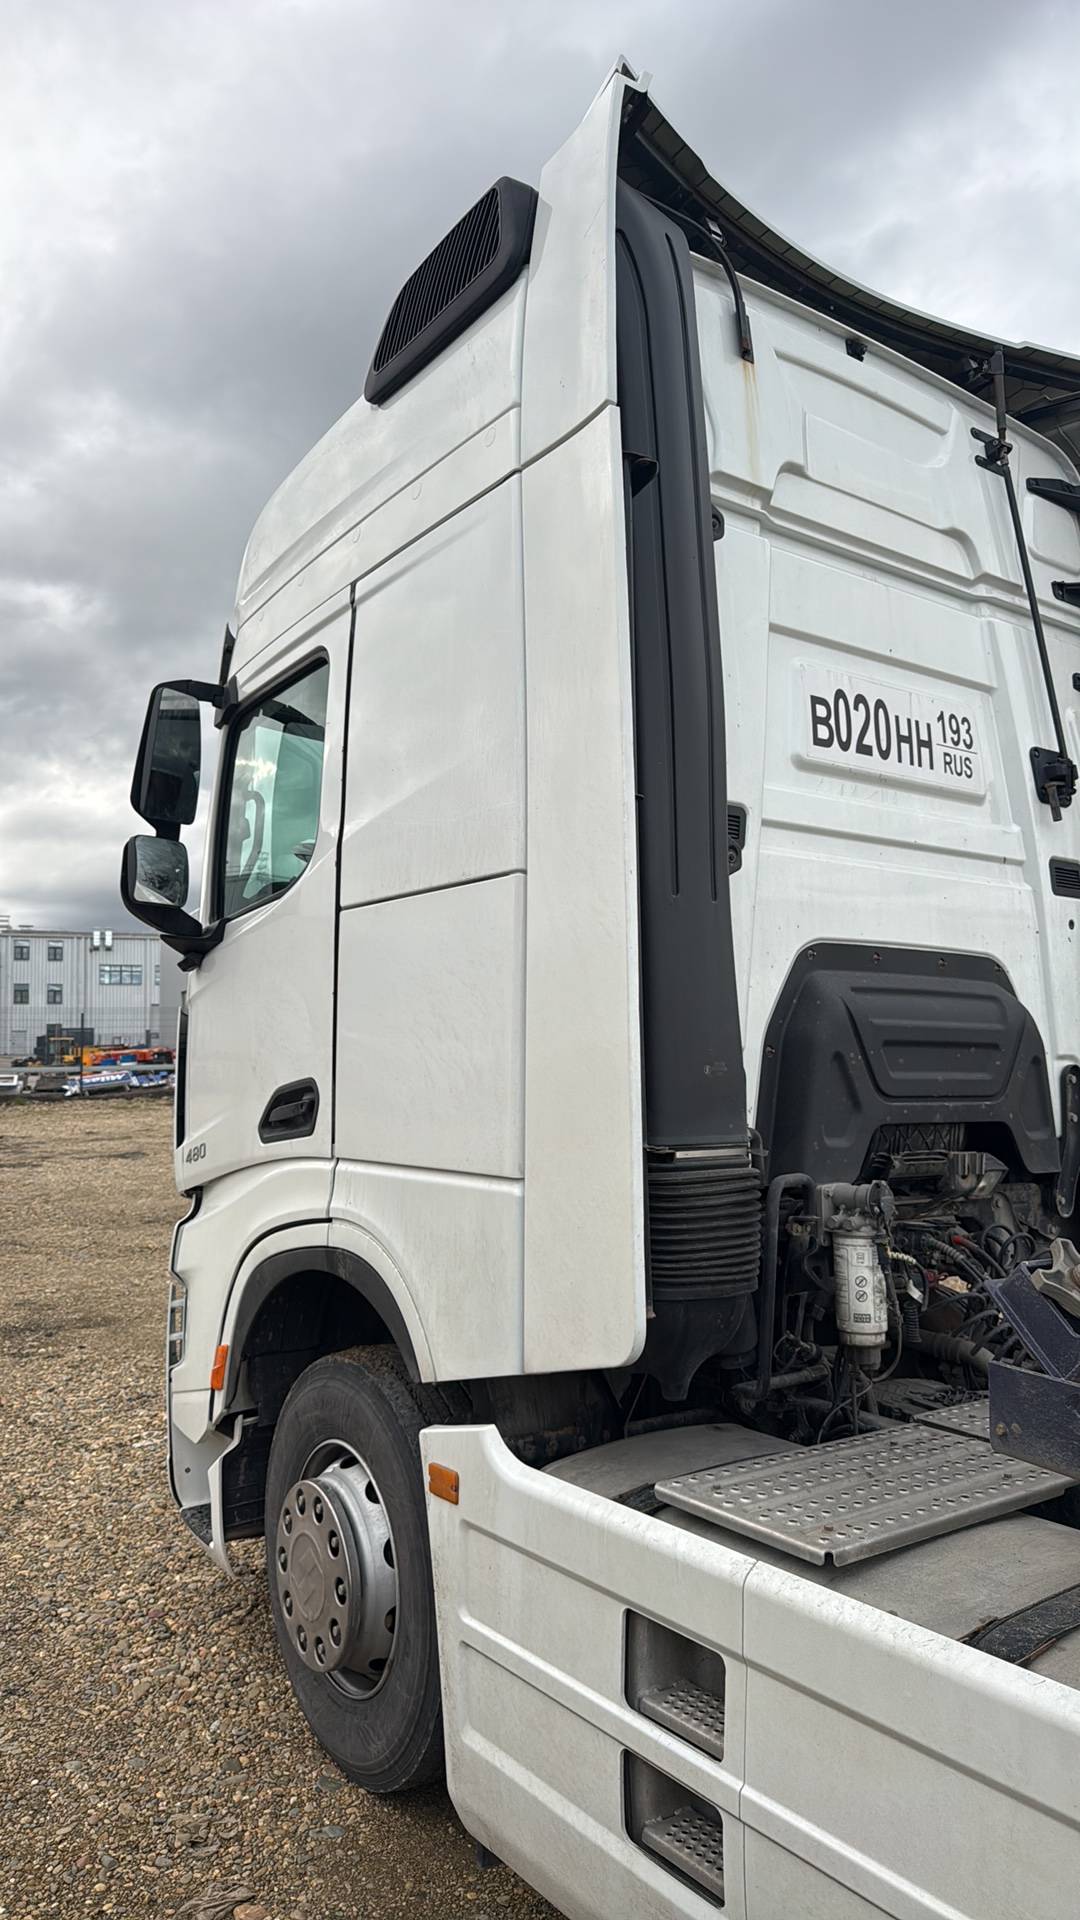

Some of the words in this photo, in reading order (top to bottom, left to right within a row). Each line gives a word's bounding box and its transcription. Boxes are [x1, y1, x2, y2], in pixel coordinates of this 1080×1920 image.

[937, 710, 974, 750] 193
[943, 751, 973, 779] RUS
[185, 1142, 207, 1164] 480
